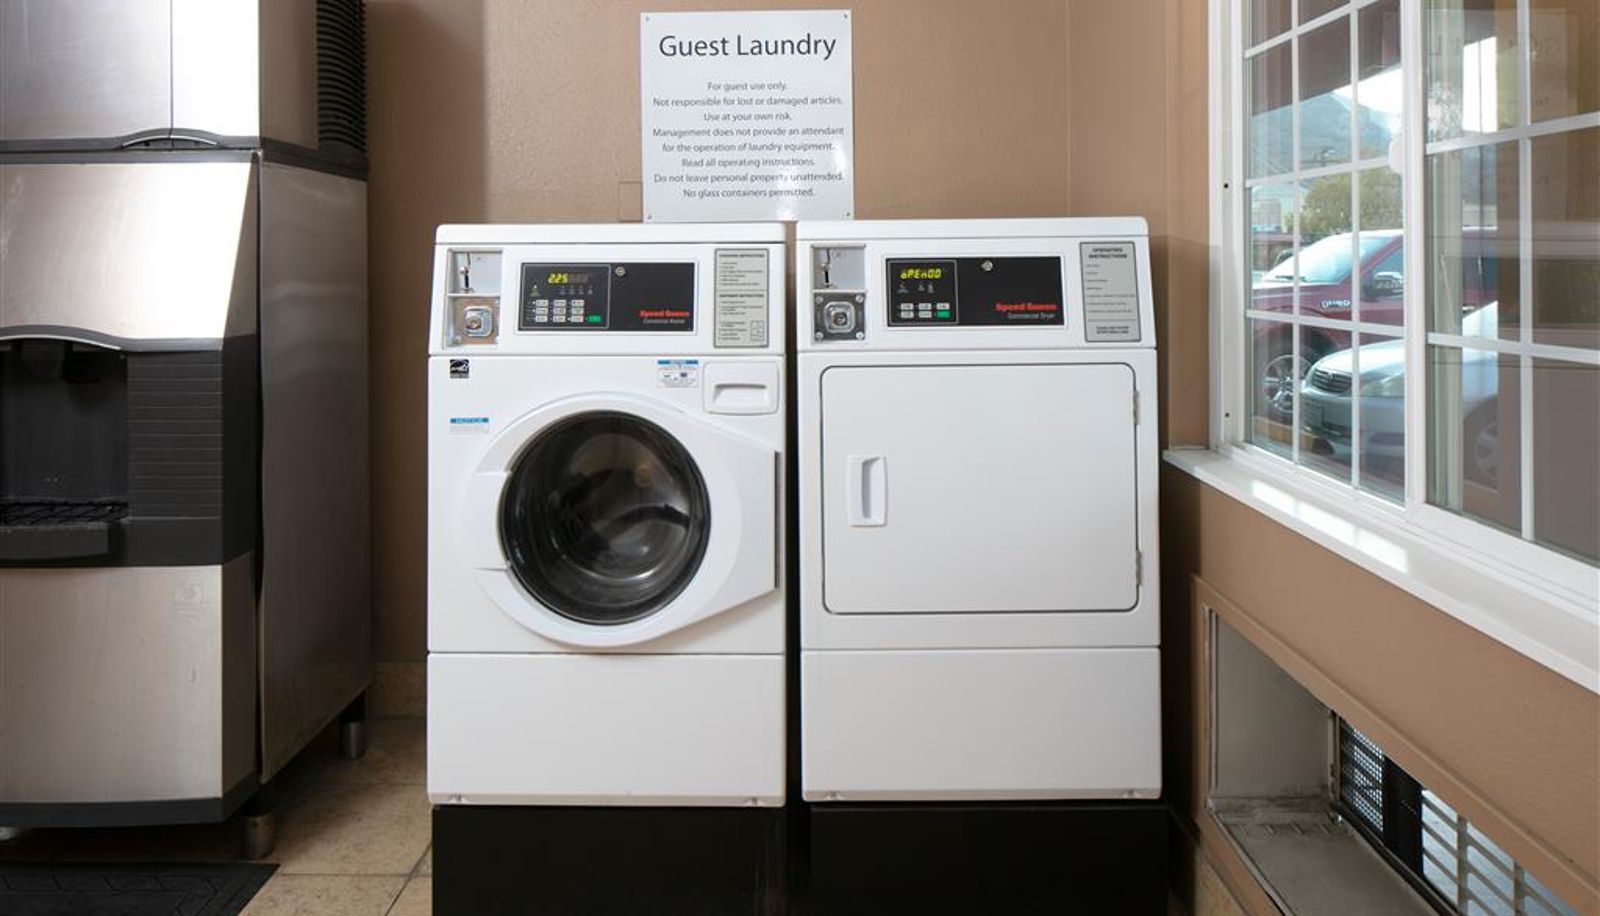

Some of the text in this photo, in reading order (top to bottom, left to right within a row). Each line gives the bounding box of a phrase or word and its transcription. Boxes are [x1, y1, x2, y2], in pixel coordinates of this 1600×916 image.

[659, 33, 836, 60] Guest Laundry
[707, 82, 720, 91] For
[723, 82, 747, 92] guest
[750, 83, 766, 91] use
[653, 97, 669, 106] Not
[671, 96, 721, 109] responsible
[723, 96, 735, 105] for
[737, 96, 753, 105] lost
[766, 95, 808, 107] damaged
[809, 95, 844, 105] articles.
[704, 112, 792, 123] Use at your own risk.
[652, 126, 845, 139] Management does not provide an attendant
[662, 142, 836, 154] for the operation of laundry equipment.
[682, 158, 704, 167] Read
[705, 158, 716, 167] all
[718, 158, 760, 168] operating
[654, 174, 668, 183] Do
[669, 174, 684, 183] not
[686, 173, 709, 182] leave
[711, 172, 748, 184] personal
[790, 172, 845, 182] unattended.
[683, 189, 697, 198] No
[698, 188, 720, 199] glass
[721, 188, 767, 198] containers
[547, 273, 569, 285] 225
[996, 303, 1025, 312] Speed
